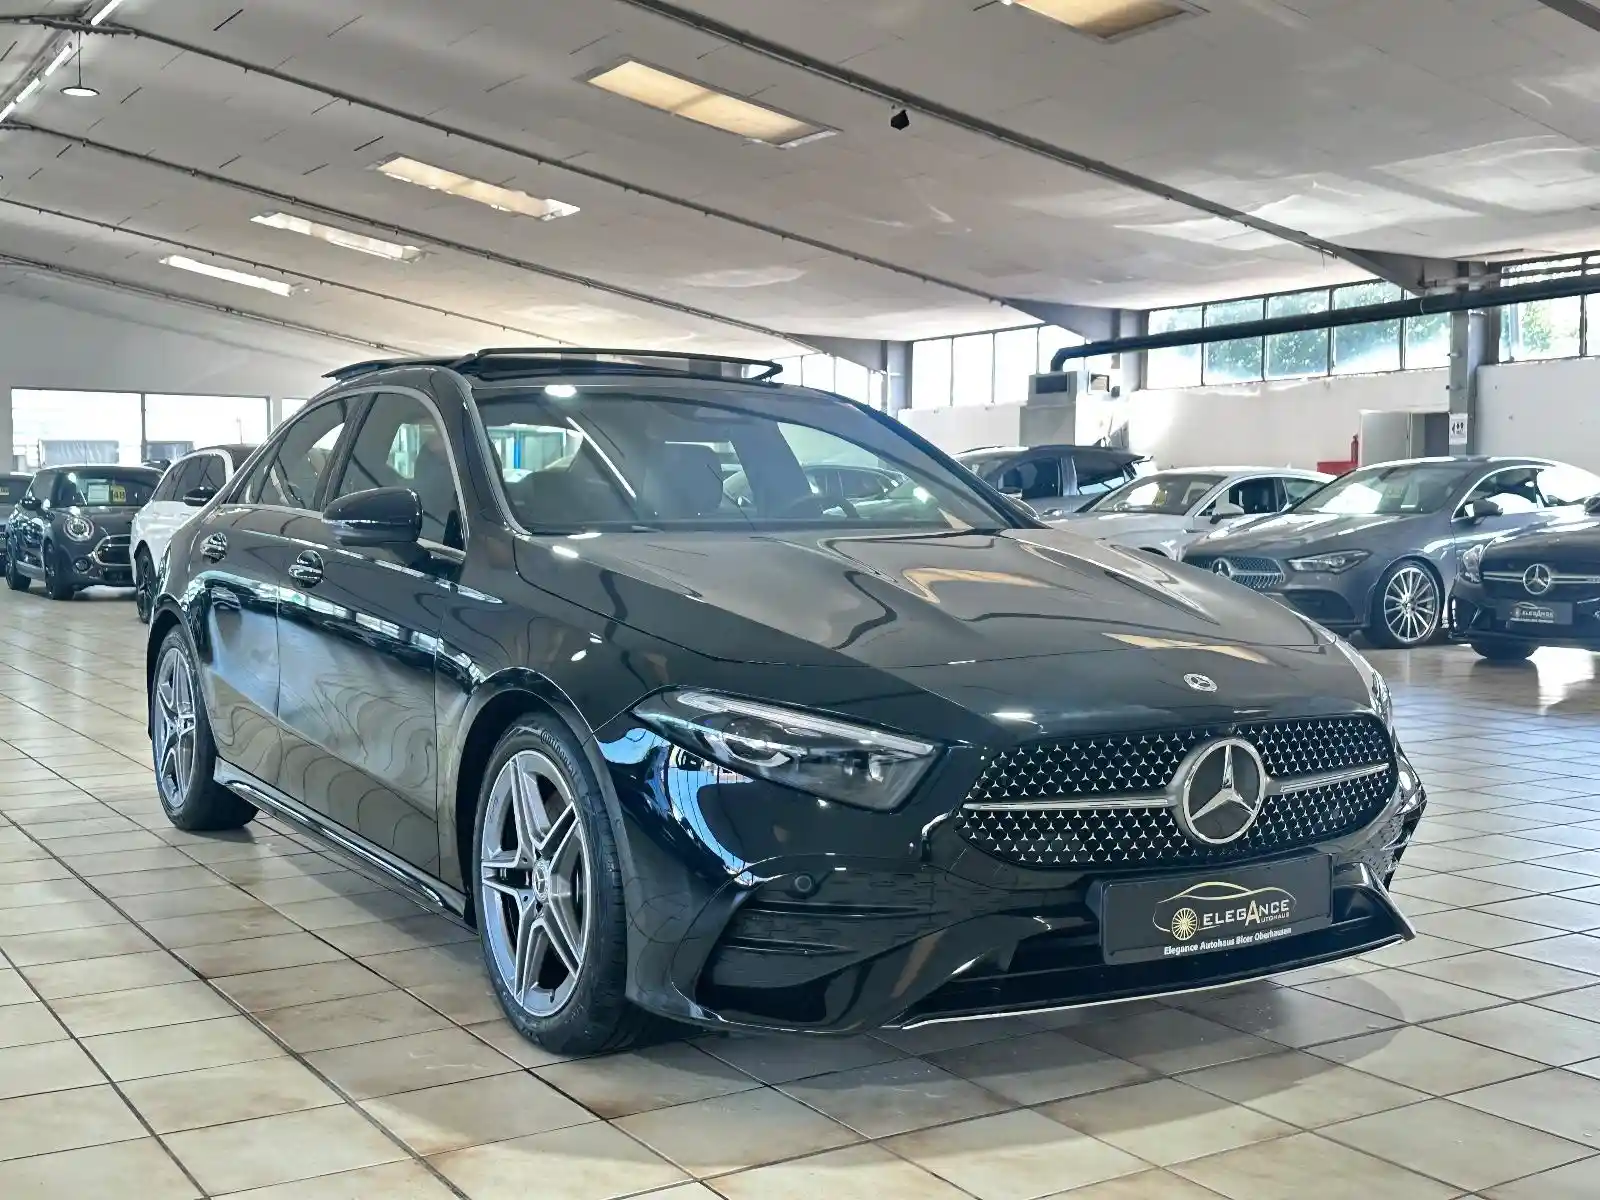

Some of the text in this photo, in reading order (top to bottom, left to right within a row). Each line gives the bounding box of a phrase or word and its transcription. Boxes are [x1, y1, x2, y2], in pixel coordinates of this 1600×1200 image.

[1203, 899, 1290, 927] ELEGANCE
[1164, 943, 1199, 956] Elegance
[1200, 938, 1235, 950] Autohaus
[1254, 927, 1292, 941] Oberhausen
